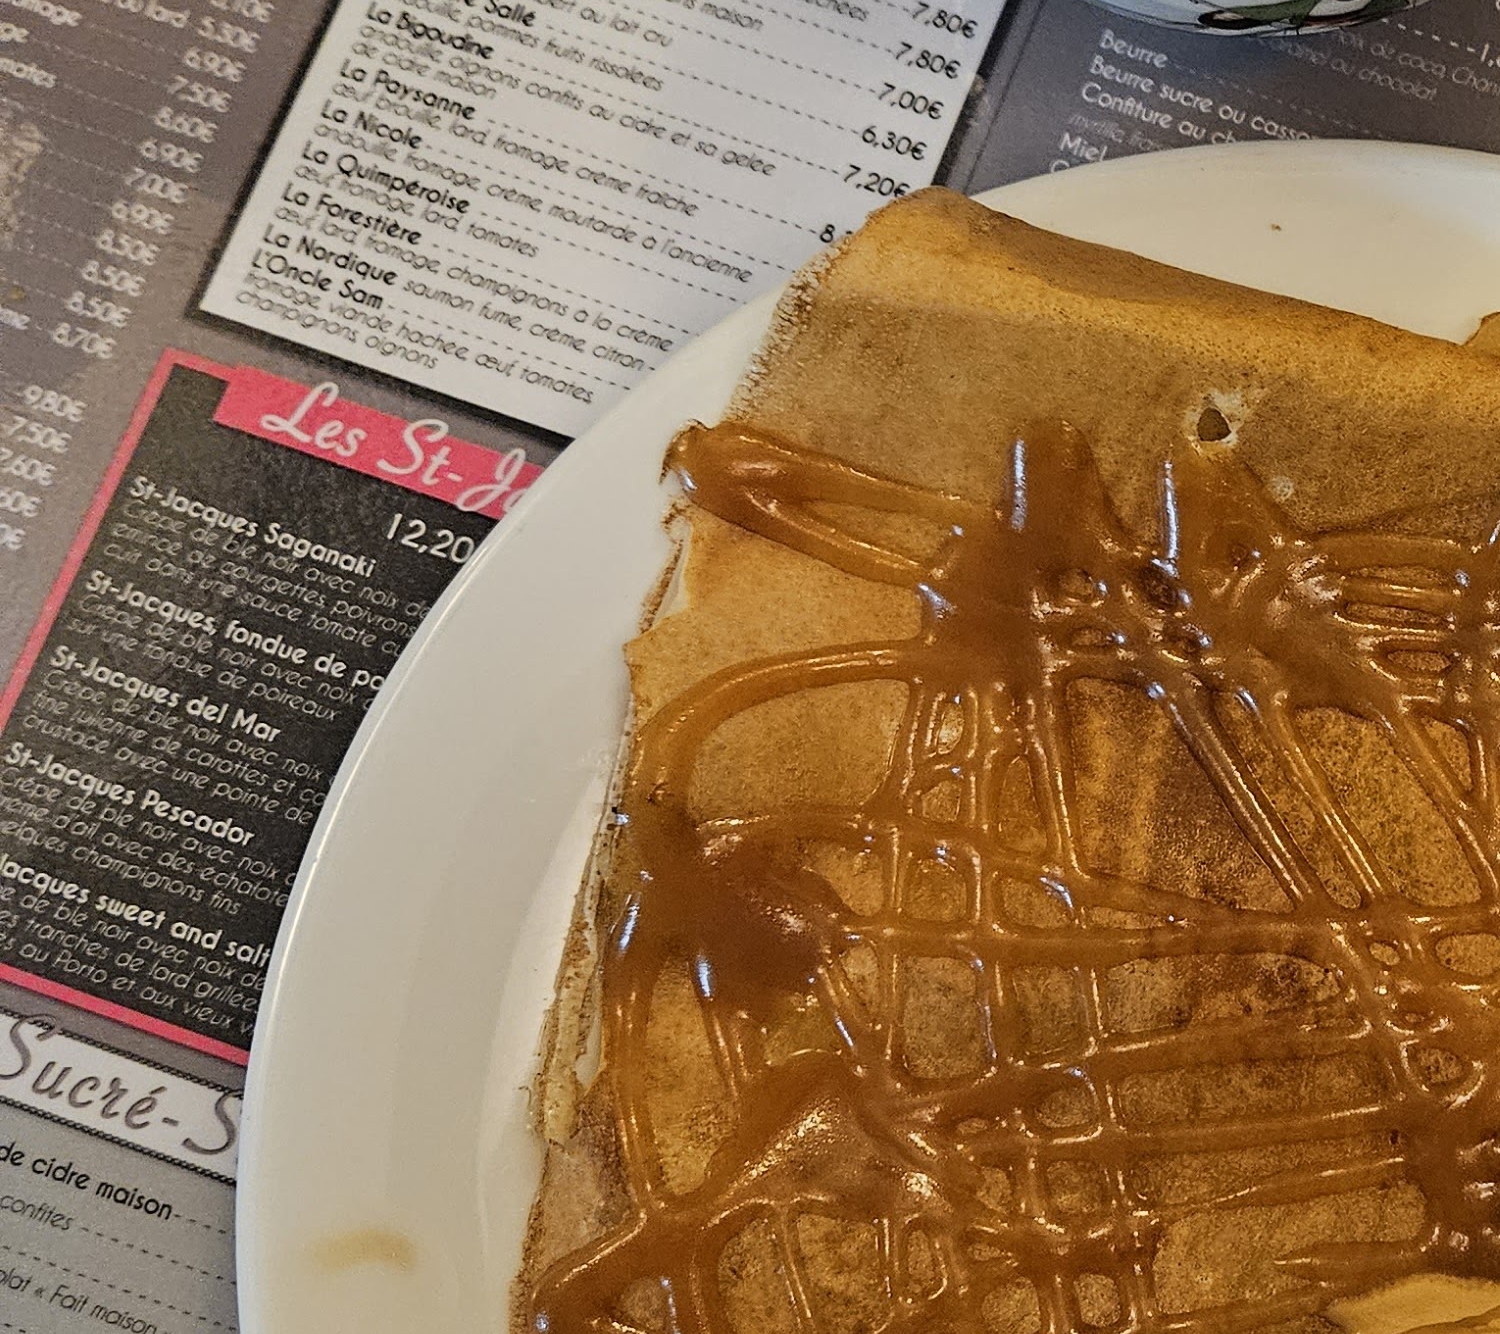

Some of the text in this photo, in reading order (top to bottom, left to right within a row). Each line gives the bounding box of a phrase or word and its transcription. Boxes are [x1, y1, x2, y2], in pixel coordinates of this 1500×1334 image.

[913, 1, 976, 38] 7,80€
[896, 41, 959, 78] 7,80€
[1100, 29, 1166, 67] Beurre
[340, 65, 474, 119] La Paysanne
[367, 6, 394, 24] La
[844, 164, 908, 205] 7,20€
[879, 82, 943, 119] 7,00€
[1081, 82, 1206, 139] Confiture au
[1090, 55, 1246, 124] Beurre sucre ou
[321, 105, 421, 148] La Nicole
[861, 126, 926, 160] 6,30€
[1060, 133, 1107, 165] Miel
[302, 145, 468, 213] La Quimpéroise
[283, 186, 420, 244] La Forestière
[252, 253, 383, 308] L'Oncle Sam
[263, 228, 396, 285] La Nordique
[262, 380, 366, 456] Les
[131, 476, 375, 579] St-Jacques Saganaki
[387, 513, 473, 568] 12,20
[87, 571, 348, 680] St-Jacques, fondue de
[51, 646, 279, 741] St-Jacques del Mar
[5, 743, 252, 844] St-Jacques Pescador
[96, 895, 164, 928] sweet
[170, 921, 222, 949] and
[31, 1158, 171, 1219] cidre maison
[49, 1284, 88, 1312] Fait
